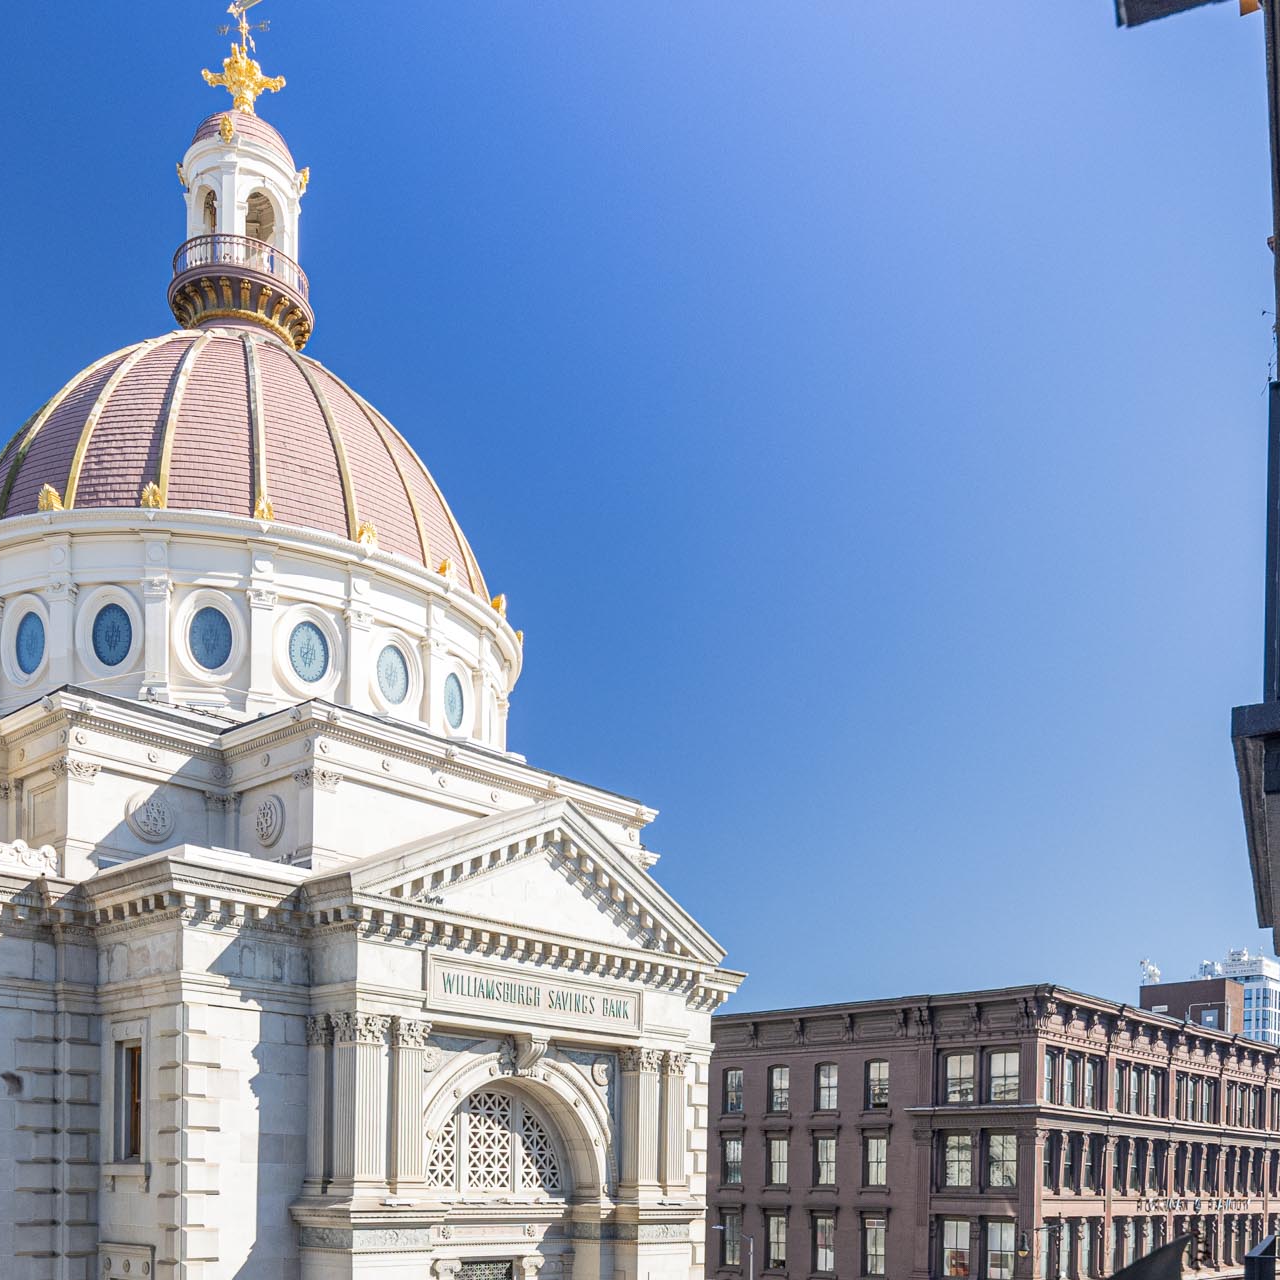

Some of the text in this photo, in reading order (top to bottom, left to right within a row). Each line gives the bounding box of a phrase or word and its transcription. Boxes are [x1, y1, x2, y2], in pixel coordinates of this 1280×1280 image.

[442, 971, 630, 1020] WILLIAMSBURGH SAVINGS BANK
